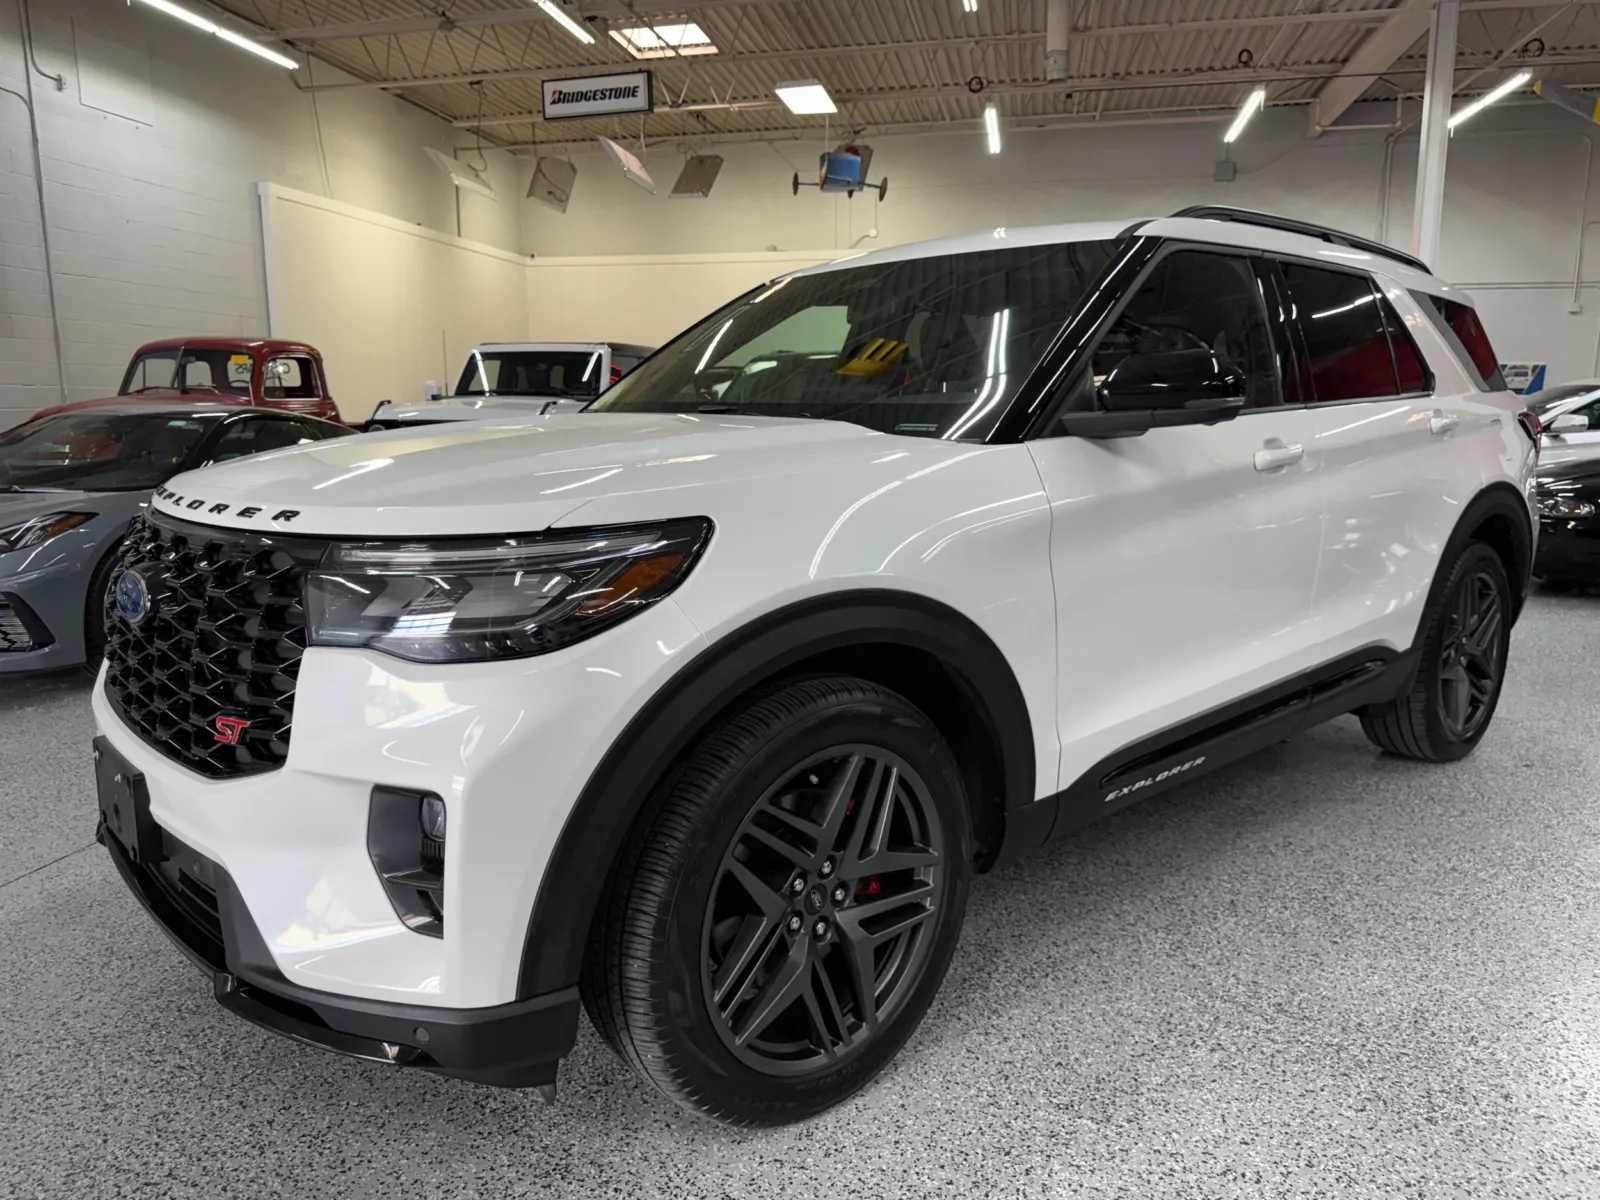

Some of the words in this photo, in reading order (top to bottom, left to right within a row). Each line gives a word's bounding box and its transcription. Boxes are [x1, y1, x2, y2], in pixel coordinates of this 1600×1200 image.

[549, 85, 640, 105] BRIDGESTONE
[214, 715, 250, 744] ST
[1104, 756, 1206, 802] EXPLORER
